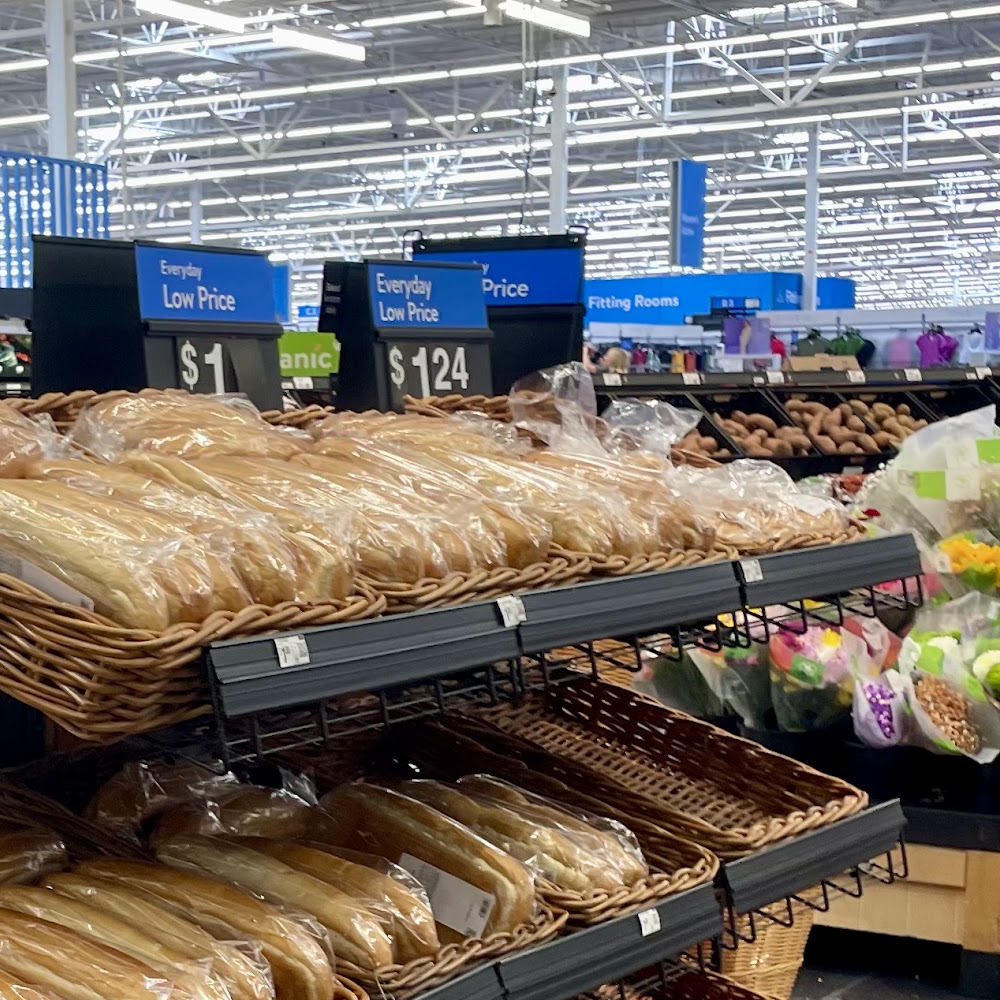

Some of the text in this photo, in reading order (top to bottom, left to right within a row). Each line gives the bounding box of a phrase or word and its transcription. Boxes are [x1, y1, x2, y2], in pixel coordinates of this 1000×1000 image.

[160, 259, 203, 281] Everyday
[162, 284, 236, 311] Low Price
[375, 272, 432, 300] Everyday
[379, 301, 439, 323] Low Price
[588, 294, 679, 312] Fitting Rooms
[280, 343, 333, 369] anic
